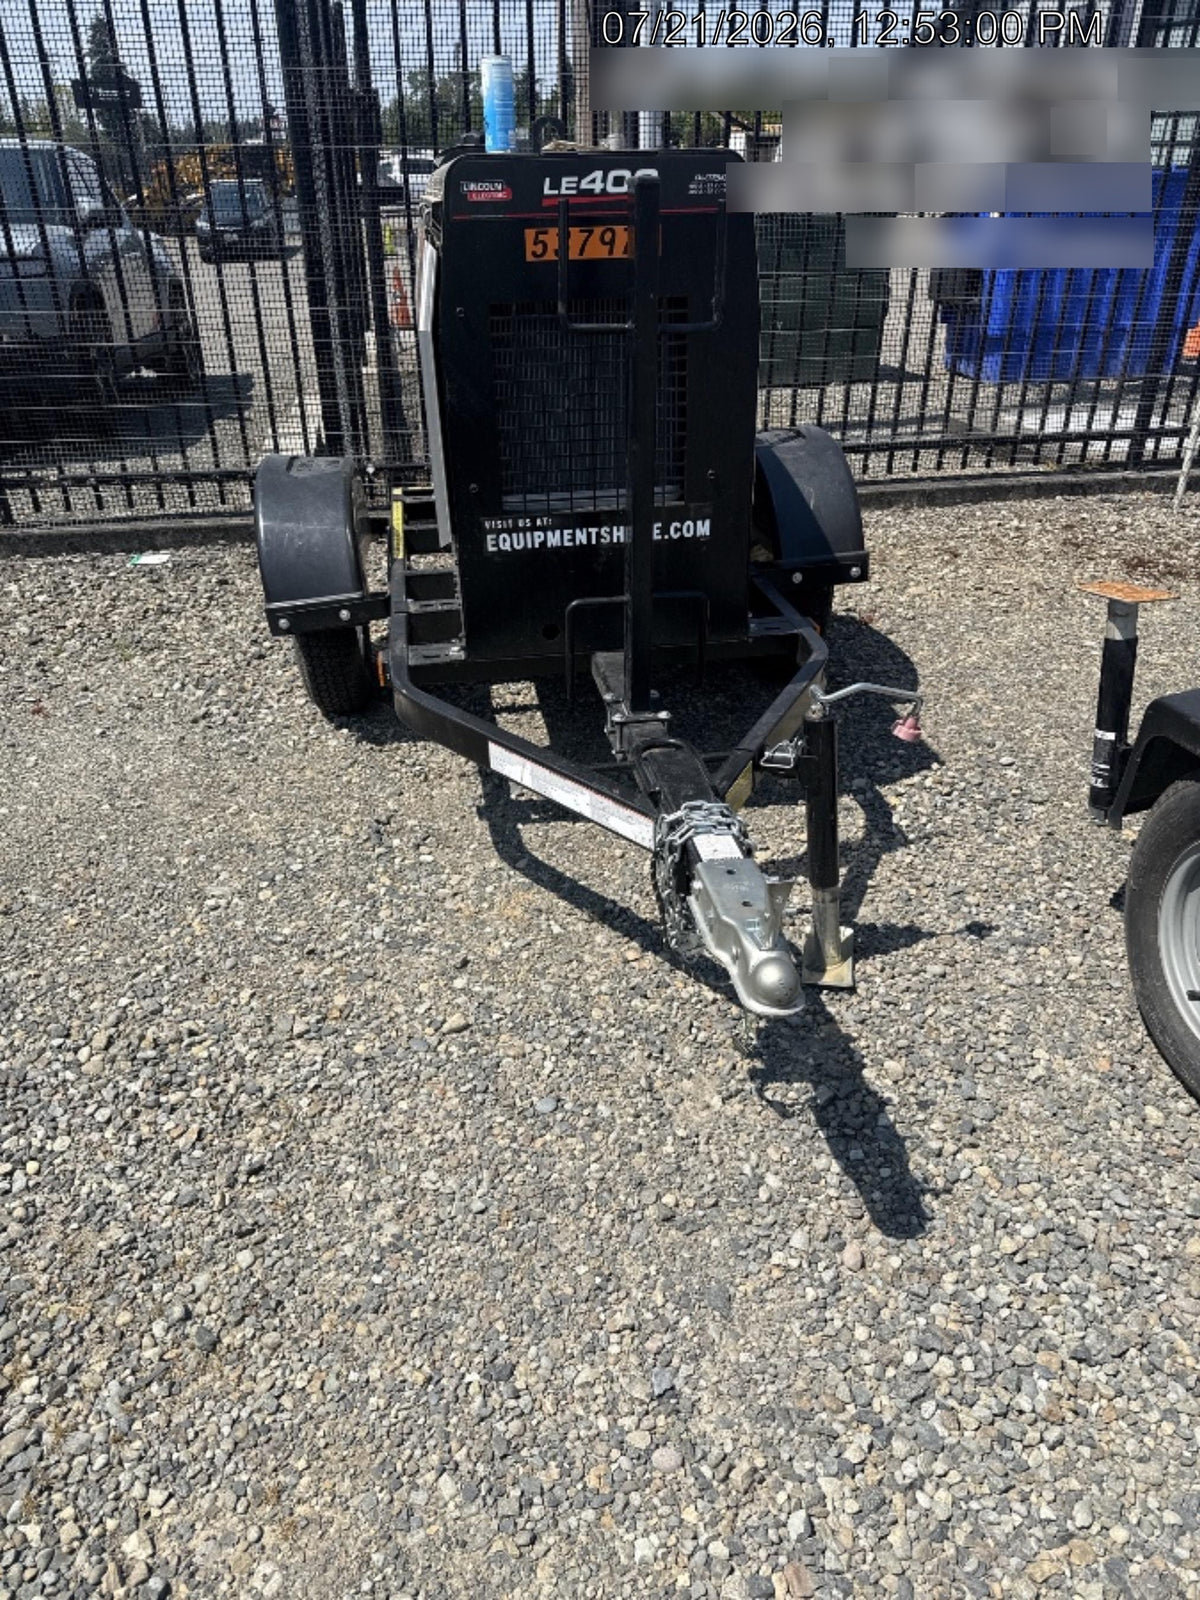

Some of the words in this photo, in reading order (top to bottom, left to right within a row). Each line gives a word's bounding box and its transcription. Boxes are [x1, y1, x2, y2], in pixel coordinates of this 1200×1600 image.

[463, 182, 503, 191] LINCOLN
[485, 518, 514, 529] VISIT
[518, 518, 532, 528] US
[536, 517, 553, 528] AT:
[486, 519, 711, 551] EQUIPMENTSHE.COM
